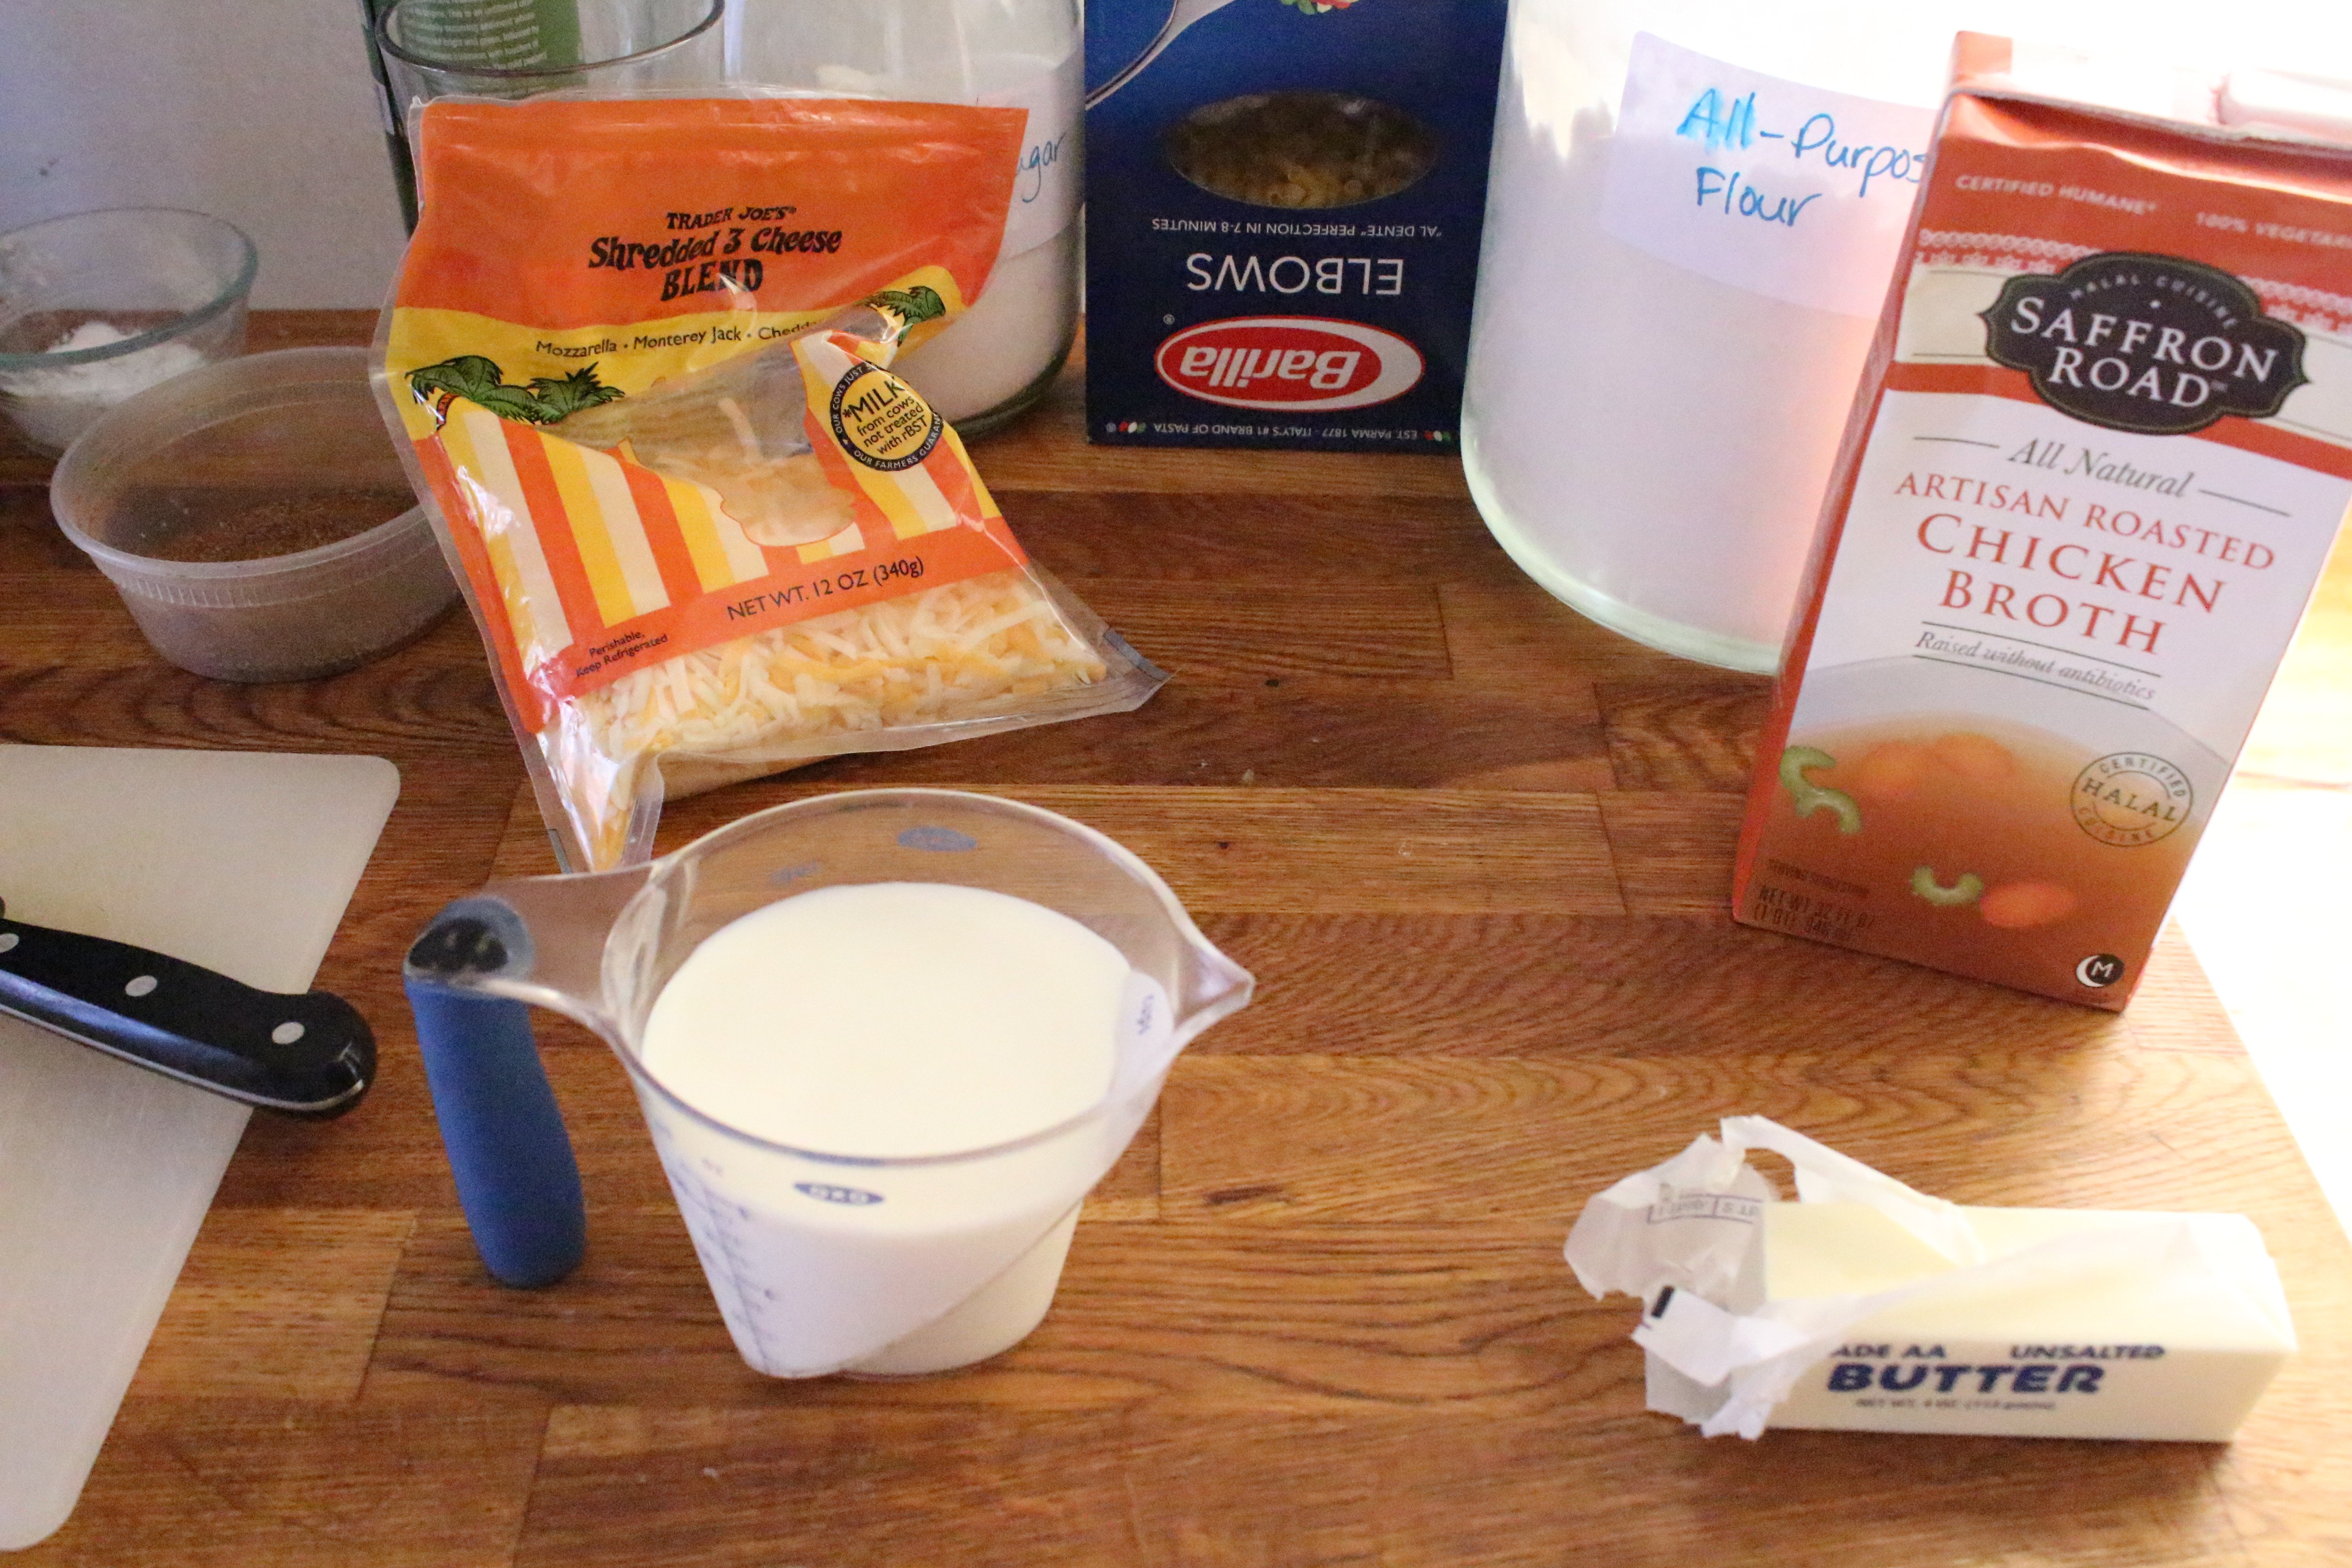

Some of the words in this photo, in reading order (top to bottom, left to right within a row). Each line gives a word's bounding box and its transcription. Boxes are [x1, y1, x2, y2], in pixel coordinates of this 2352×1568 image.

[1676, 87, 1927, 198] All-Purpos
[1696, 167, 1823, 227] Flour
[1955, 174, 2055, 197] CERTIFIED
[666, 208, 733, 230] TRADER
[1152, 218, 1216, 233] MINUTES
[1221, 221, 1241, 233] 7-8
[1246, 223, 1262, 234] IN
[1267, 222, 1356, 236] PERFECTION
[2196, 212, 2247, 233] 100%
[588, 231, 720, 270] Shredded
[723, 228, 743, 254] 3
[751, 227, 843, 254] Cheese
[660, 258, 764, 302] BLEND
[1186, 252, 1404, 295] ELBOWS
[536, 338, 617, 358] Mozzarella
[633, 331, 706, 350] Monterey
[711, 326, 741, 343] Jack
[2010, 297, 2278, 383] SAFFRON
[844, 367, 863, 384] JUST
[1180, 345, 1361, 390] Barilla
[2048, 346, 2210, 408] ROAD
[833, 385, 845, 409] COWS
[857, 416, 885, 436] from
[886, 396, 915, 418] cows
[833, 416, 843, 433] OUR
[854, 450, 872, 466] OUR
[875, 455, 918, 469] FARMERS
[919, 415, 941, 456] GUARAN
[863, 431, 884, 447] not
[884, 402, 924, 433] treated
[877, 435, 902, 455] with
[903, 414, 927, 441] rBST
[1154, 422, 1188, 434] PASTA
[1192, 424, 1209, 434] OF
[1212, 424, 1253, 436] BRAND
[1257, 426, 1269, 436] #1
[1321, 427, 1347, 438] 1877
[1351, 428, 1392, 439] PARMA
[2009, 438, 2059, 469] All
[2063, 448, 2195, 498] Natural
[1894, 471, 2070, 521] ARTISAN
[2083, 503, 2275, 571] ROASTED
[1917, 512, 2226, 614] CHICKEN
[727, 595, 767, 621] NET
[768, 585, 809, 609] WT.
[813, 578, 833, 598] 12
[838, 569, 868, 592] OZ
[873, 556, 925, 587] (340g)
[1938, 569, 2166, 655] BROTH
[576, 662, 601, 678] Keep
[603, 633, 668, 665] Refrigerated
[1915, 631, 1978, 658] Raised
[1982, 645, 2055, 675] without
[2058, 665, 2156, 701] antibiotics
[2099, 757, 2186, 797] CERTIFIED
[2082, 777, 2176, 822] HALAL
[1902, 1344, 1946, 1358] AA
[2009, 1344, 2166, 1359] UNSALTED
[1828, 1363, 2105, 1393] BUTTER
